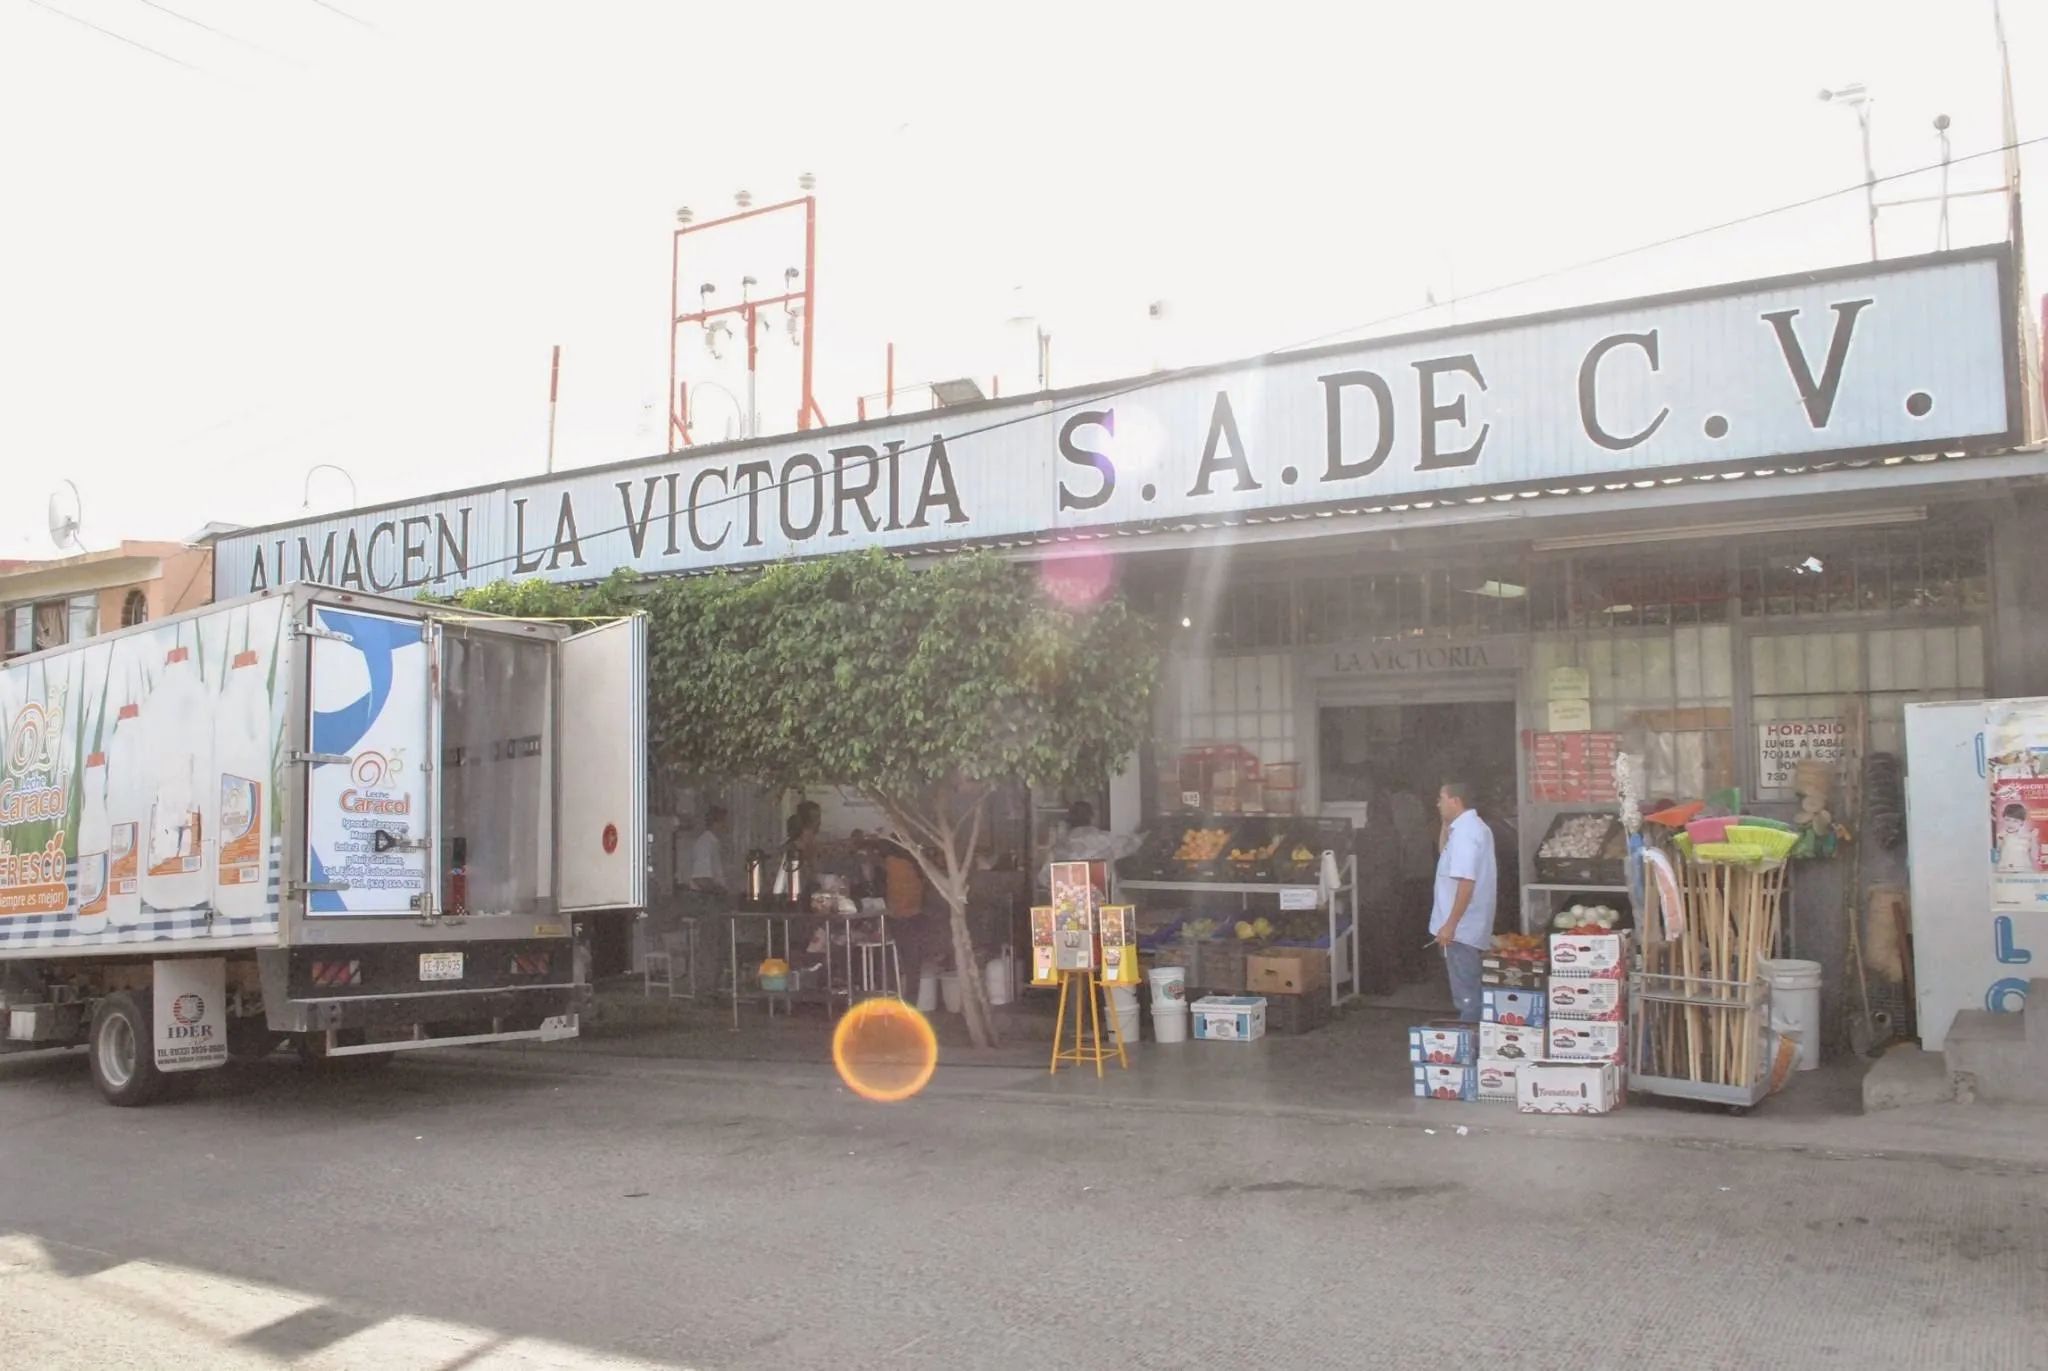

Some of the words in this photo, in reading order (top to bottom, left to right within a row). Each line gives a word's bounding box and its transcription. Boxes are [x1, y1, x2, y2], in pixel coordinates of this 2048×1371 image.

[251, 508, 472, 593] ALMACEN
[513, 491, 587, 575] LA
[615, 434, 970, 559] VICTORIA
[1333, 652, 1363, 672] LA
[1371, 646, 1489, 670] VICTORIA
[1767, 724, 1846, 736] HORARIO
[1765, 739, 1795, 748] LUNES
[0, 769, 69, 823] Caracol
[339, 788, 412, 815] Caracol
[167, 1024, 214, 1039] IDER
